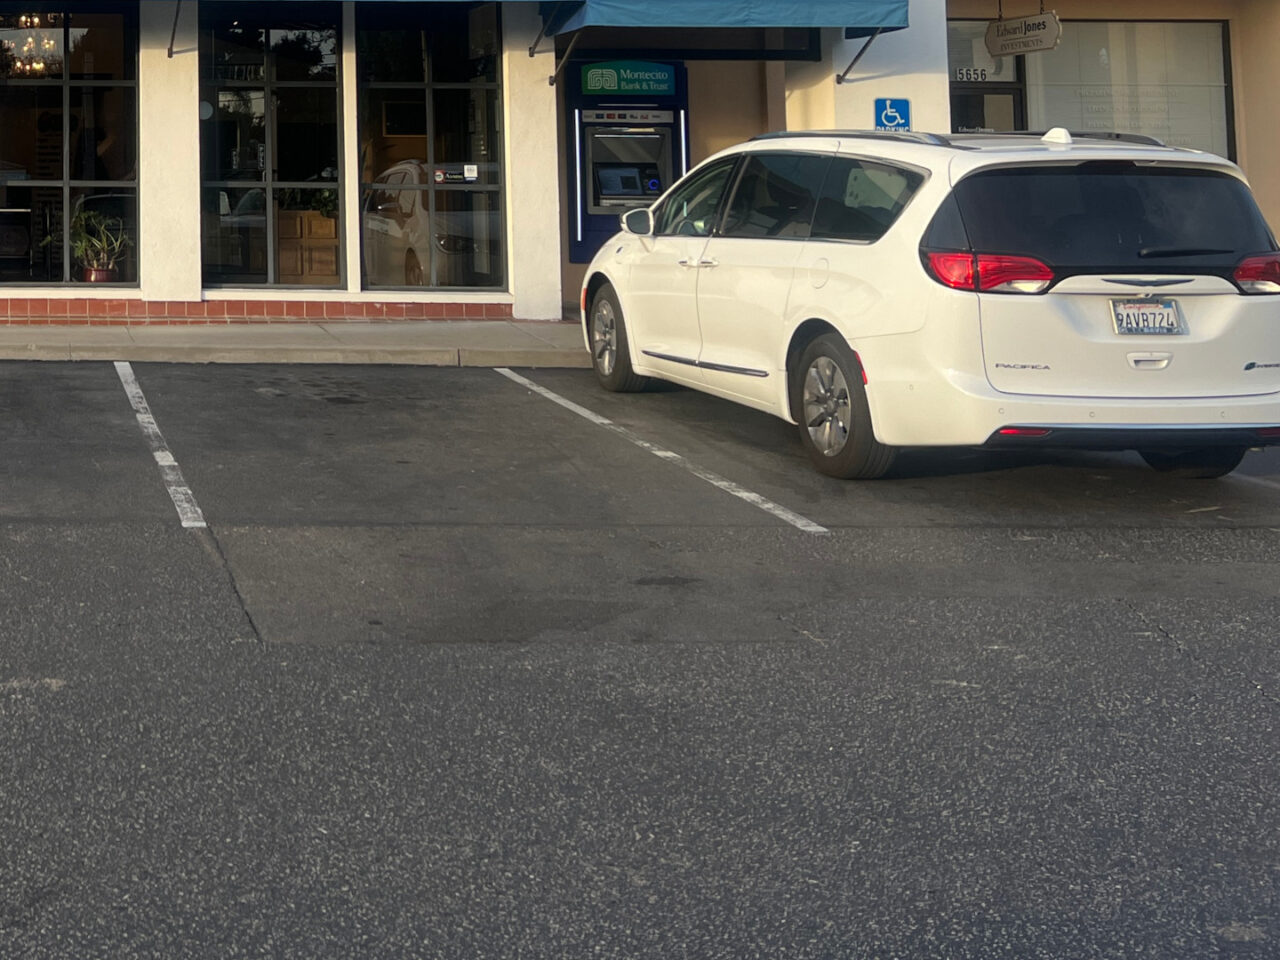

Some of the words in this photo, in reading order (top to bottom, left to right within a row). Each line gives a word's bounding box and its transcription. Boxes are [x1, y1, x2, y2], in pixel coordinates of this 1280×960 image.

[1023, 20, 1047, 35] Jones
[619, 68, 669, 80] Montecito
[958, 68, 987, 81] 5656
[620, 81, 640, 90] Bank
[641, 81, 649, 90] &
[648, 81, 669, 90] Trust
[1116, 312, 1175, 328] 9AVB724
